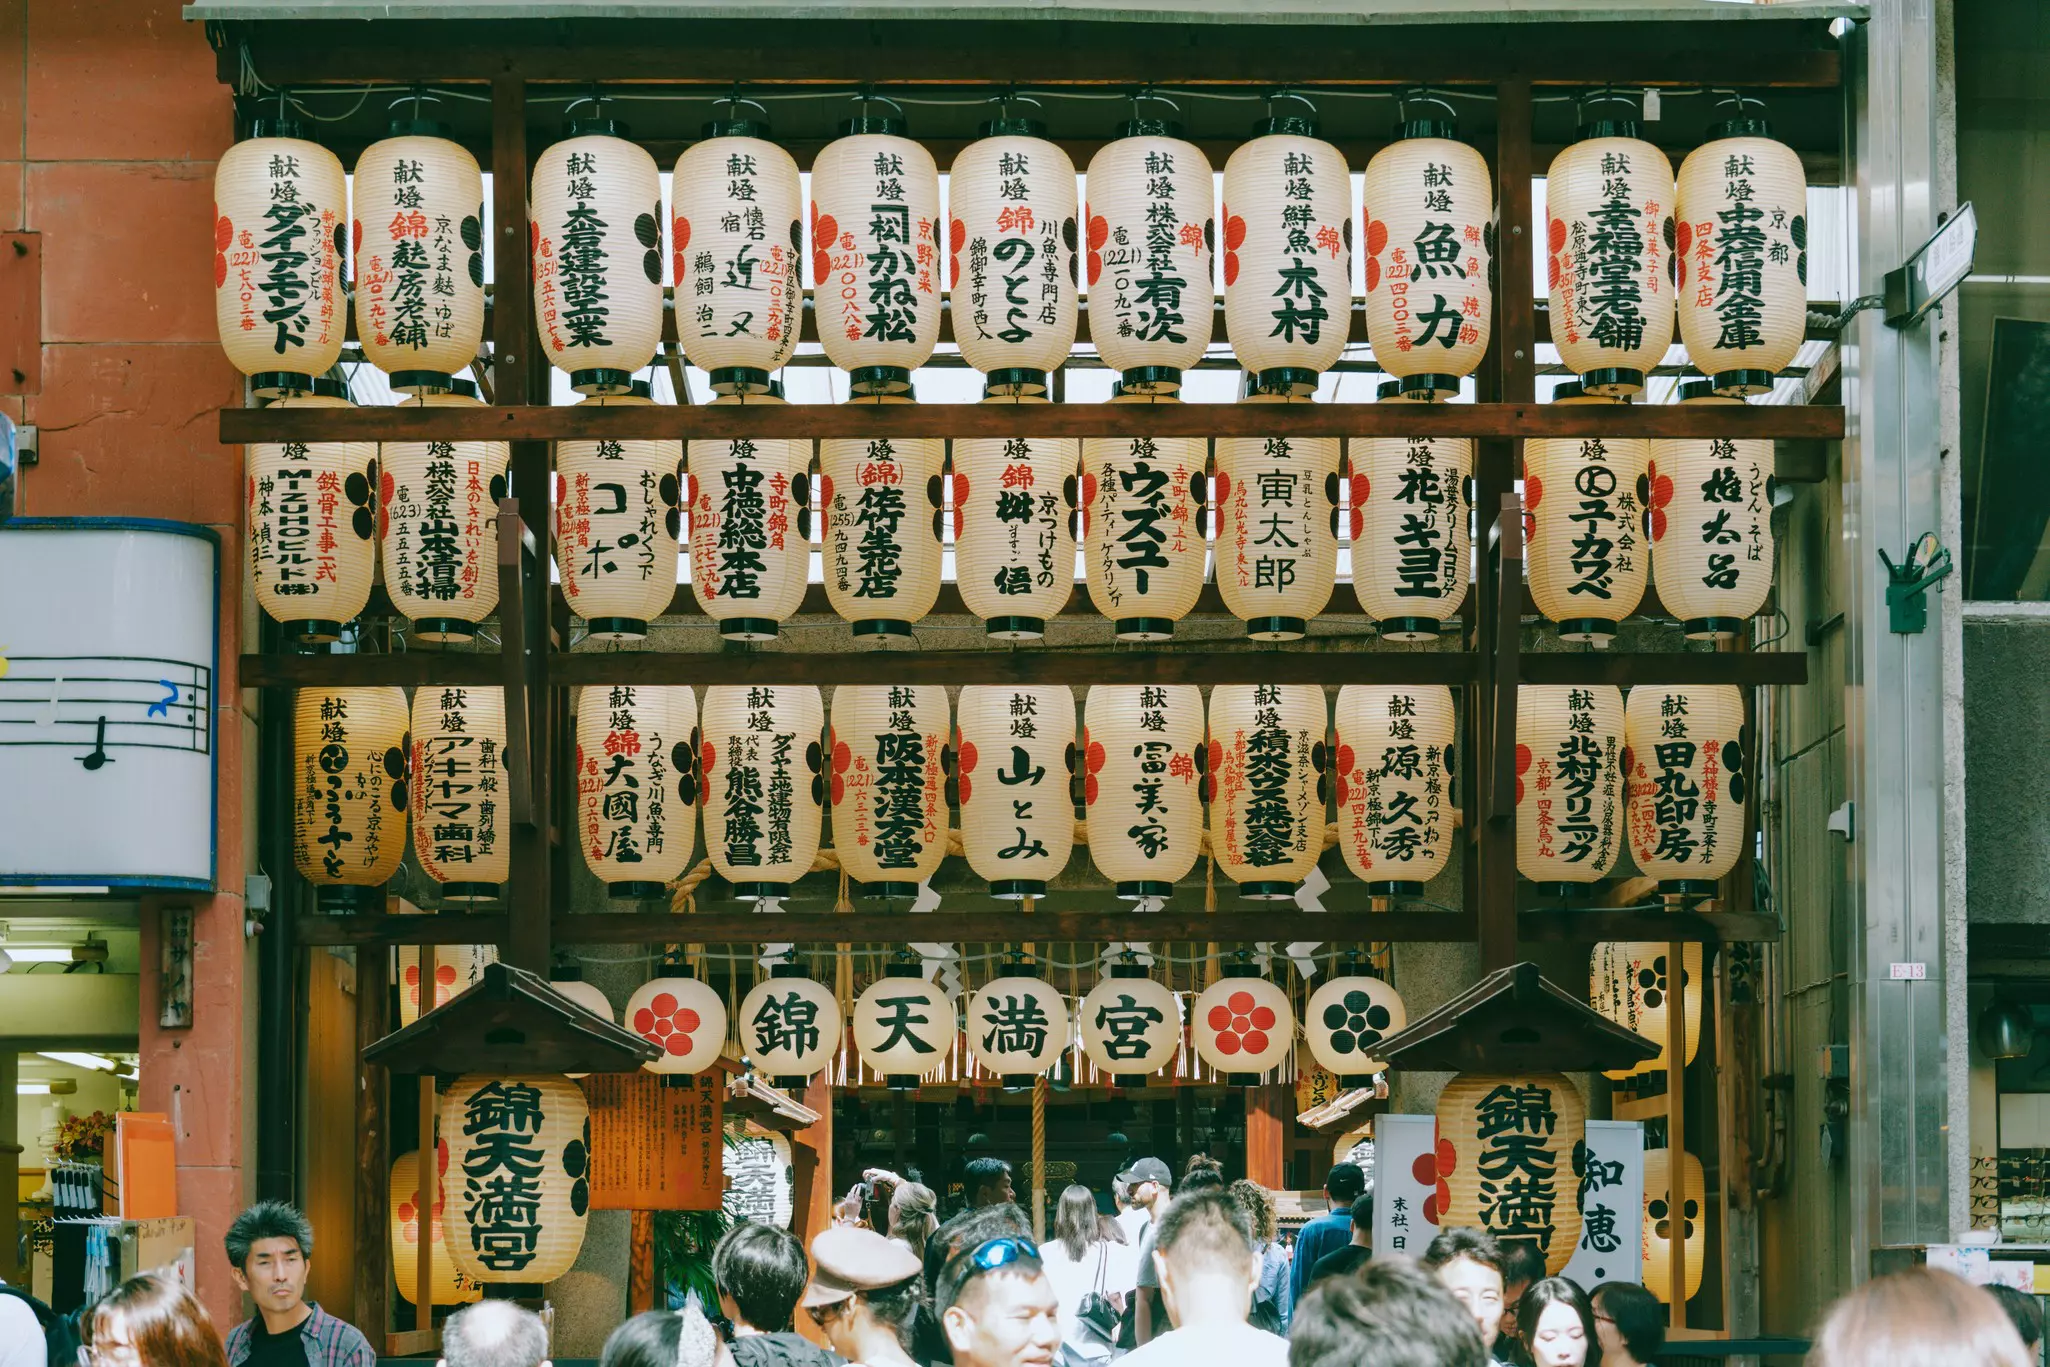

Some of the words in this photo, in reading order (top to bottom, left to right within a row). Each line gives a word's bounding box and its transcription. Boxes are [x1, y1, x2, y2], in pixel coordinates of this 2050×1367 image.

[269, 154, 301, 204] 献燈
[393, 159, 425, 209] 献燈
[566, 153, 597, 199] 献燈
[726, 153, 758, 201] 献燈
[874, 152, 905, 201] 献燈
[999, 152, 1030, 201] 献燈
[1144, 151, 1176, 200] 献燈
[1284, 152, 1315, 201] 献燈
[1423, 162, 1454, 213] 献燈
[1600, 152, 1632, 200] 献燈
[1724, 154, 1756, 201] 献燈
[388, 210, 429, 241] 錦
[721, 211, 740, 233] 宿
[743, 206, 766, 240] 懐石
[917, 217, 933, 294] 京野菜
[996, 205, 1034, 235] 錦
[1144, 202, 1179, 272] 株式会社
[1178, 222, 1203, 257] 錦
[1280, 204, 1317, 255] 鮮魚
[1315, 225, 1340, 260] 錦
[1644, 200, 1660, 294] 御生菓子司
[1767, 205, 1789, 266] 京都
[258, 202, 316, 354] ダイアモンド
[309, 217, 322, 300] ファッションビル
[558, 202, 613, 347] 大岩建設工業
[720, 244, 768, 340] 近又
[863, 244, 917, 343] かね松
[969, 236, 994, 341] 錦御幸町西入
[993, 238, 1035, 343] のとよ
[1036, 220, 1059, 325] 川魚専門店
[1410, 220, 1466, 349] 魚力
[1459, 224, 1481, 345] 鮮魚・焼物
[1570, 221, 1592, 328] 松原通寺町東入
[1587, 200, 1647, 352] 幸福堂老舗
[1695, 221, 1716, 308] 四条支店
[1713, 202, 1767, 350] 中央信用金庫
[1134, 271, 1188, 344] 有次
[1268, 258, 1329, 345] 木村
[597, 440, 626, 461] 燈
[730, 439, 758, 460] 燈
[856, 461, 903, 487] (錦)
[867, 439, 896, 462] 燈
[999, 464, 1035, 490] 錦
[1003, 439, 1033, 461] 燈
[1130, 438, 1159, 460] 燈
[1264, 438, 1293, 460] 燈
[1579, 439, 1609, 463] 燈
[1709, 439, 1738, 461] 燈
[315, 471, 341, 583] 鉄骨工事一式
[424, 461, 459, 520] 株式会社
[638, 470, 658, 581] おしゃれくつ下
[767, 472, 789, 551] 寺町錦角
[1100, 462, 1118, 537] 各種パーティー
[1171, 464, 1189, 553] 寺町錦上ル
[1302, 470, 1313, 558] 豆乳とんしゃぶ
[1747, 462, 1764, 562] うどん・そば
[416, 520, 463, 601] 山本清掃
[461, 461, 483, 599] 日本のきれいを創る
[581, 483, 640, 580] コポ
[716, 463, 767, 599] 中徳総本店
[853, 486, 906, 599] 佐竹生花店
[1037, 491, 1059, 588] 京つけもの
[1116, 461, 1172, 595] ウィズユー
[1254, 468, 1299, 594] 寅太郎
[1615, 492, 1636, 573] 株式会社
[1100, 543, 1123, 608] ケータリング
[321, 697, 349, 743] 献燈
[441, 688, 467, 733] 献燈
[609, 686, 637, 731] 献燈
[747, 687, 775, 732] 献燈
[888, 687, 916, 732] 献燈
[1010, 693, 1038, 739] 献燈
[1140, 686, 1169, 732] 献燈
[1254, 684, 1282, 728] 献燈
[1387, 694, 1416, 740] 献燈
[1568, 689, 1596, 734] 献燈
[1661, 694, 1689, 739] 献燈
[424, 738, 435, 813] インプラント
[602, 730, 641, 757] 錦
[728, 735, 744, 767] 取締役
[745, 735, 759, 762] 代表
[1168, 752, 1195, 784] 錦
[363, 751, 383, 867] 心にのこる京みやげ
[432, 737, 477, 863] アキヤマ歯科
[477, 738, 498, 855] 歯科一般・歯列矯正
[603, 754, 643, 863] 大國屋
[646, 732, 667, 855] うなぎ川魚専門
[723, 766, 764, 866] 熊谷勝昌
[766, 732, 796, 865] ダイヤ土地建物有限会社
[873, 733, 925, 869] 阪本漢方堂
[997, 745, 1049, 859] 山とみ
[1243, 729, 1295, 867] 積水ハウス株式会社
[1365, 768, 1383, 849] 新京極錦下ル
[1555, 735, 1603, 863] 北村クリニック
[1653, 742, 1700, 863] 田丸印房
[752, 992, 820, 1059] 錦
[872, 996, 937, 1053] 天
[982, 994, 1049, 1058] 満
[1096, 994, 1164, 1060] 宮
[461, 1081, 545, 1271] 錦天満宮
